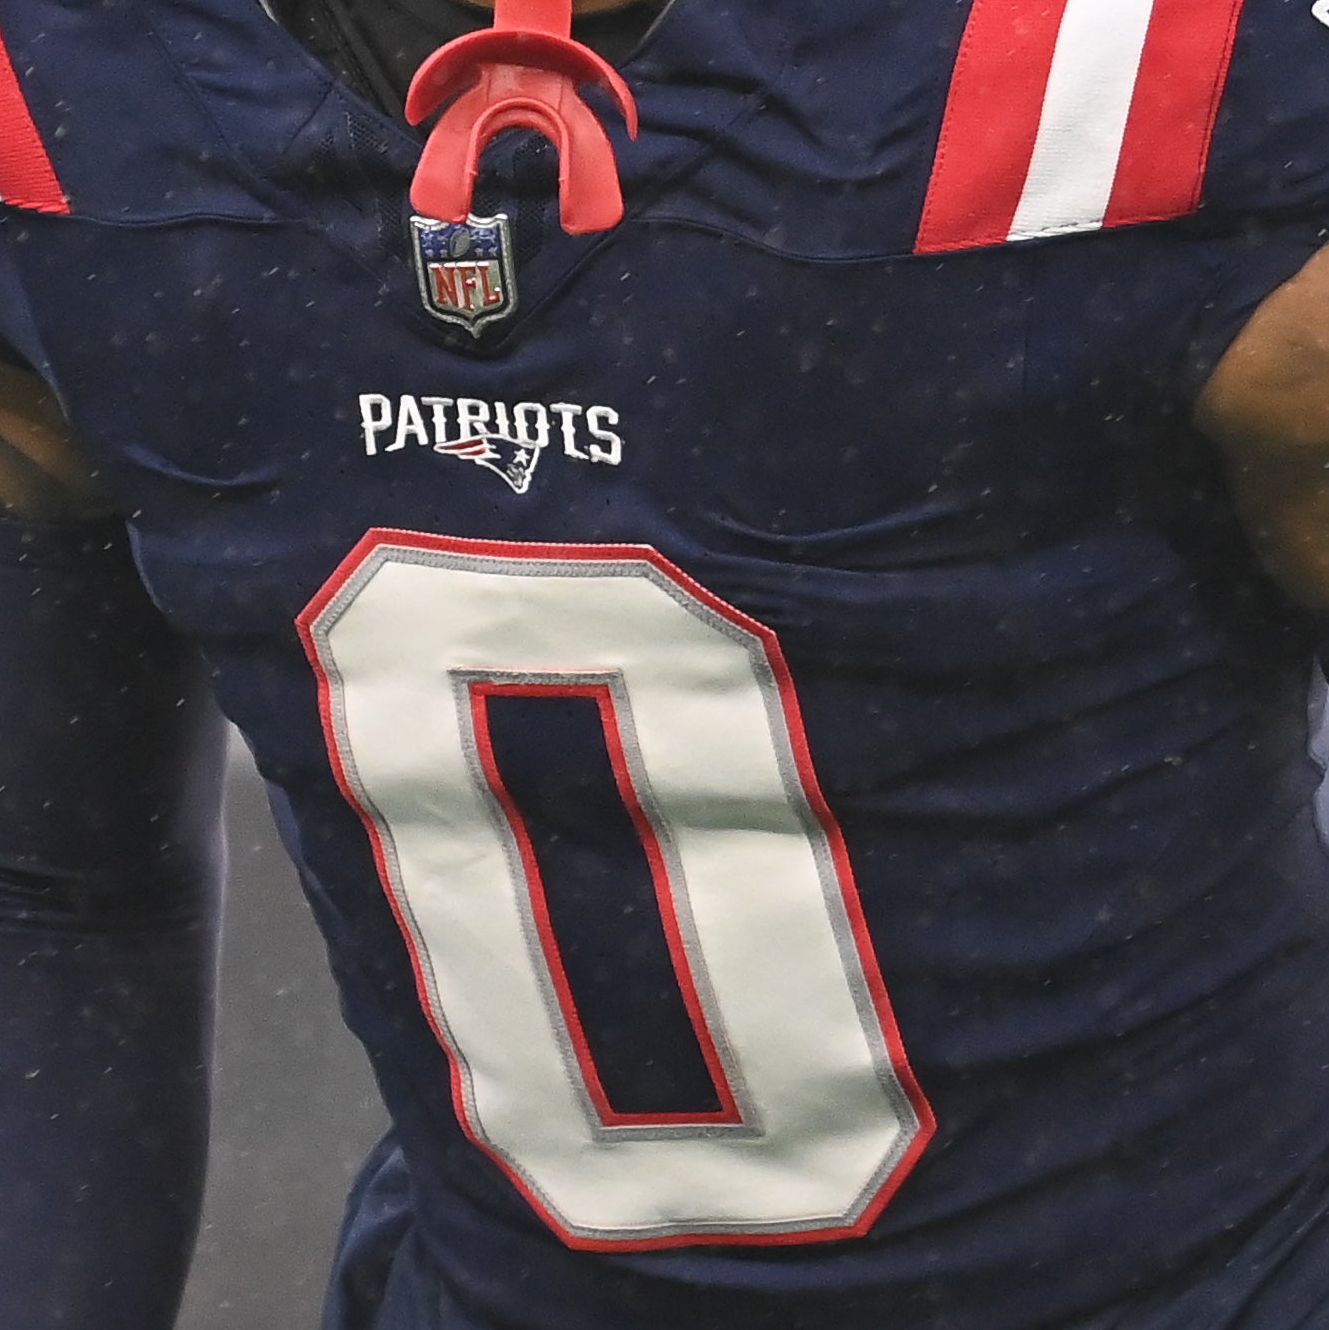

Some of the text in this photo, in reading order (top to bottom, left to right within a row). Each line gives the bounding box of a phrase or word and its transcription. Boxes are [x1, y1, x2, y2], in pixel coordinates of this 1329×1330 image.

[430, 264, 502, 312] NFL
[358, 393, 622, 466] PATRIOTS
[294, 527, 937, 1251] 0
